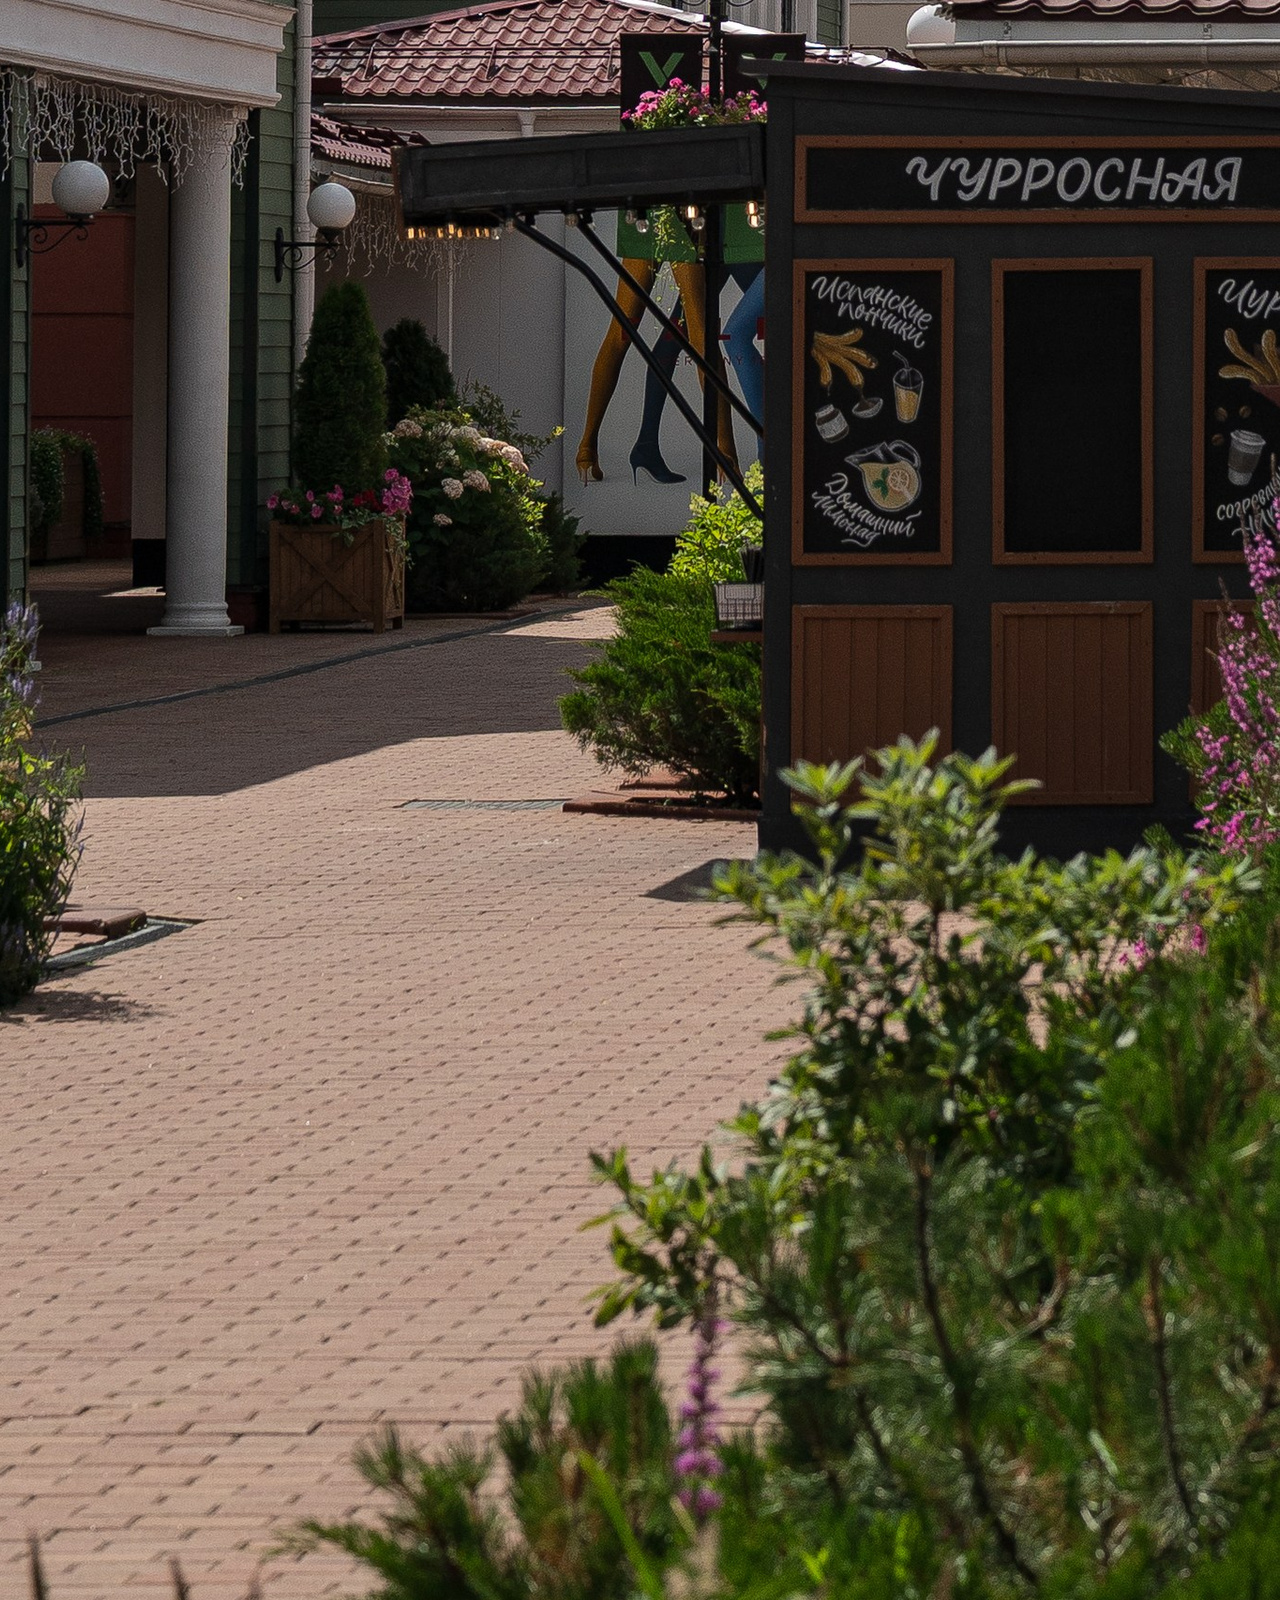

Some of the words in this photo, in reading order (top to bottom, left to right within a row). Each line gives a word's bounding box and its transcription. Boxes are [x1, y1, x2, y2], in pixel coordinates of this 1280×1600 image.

[905, 156, 1243, 202] ЧУРРОСНАЯ
[811, 276, 933, 330] Испанские
[824, 472, 923, 537] Домашний
